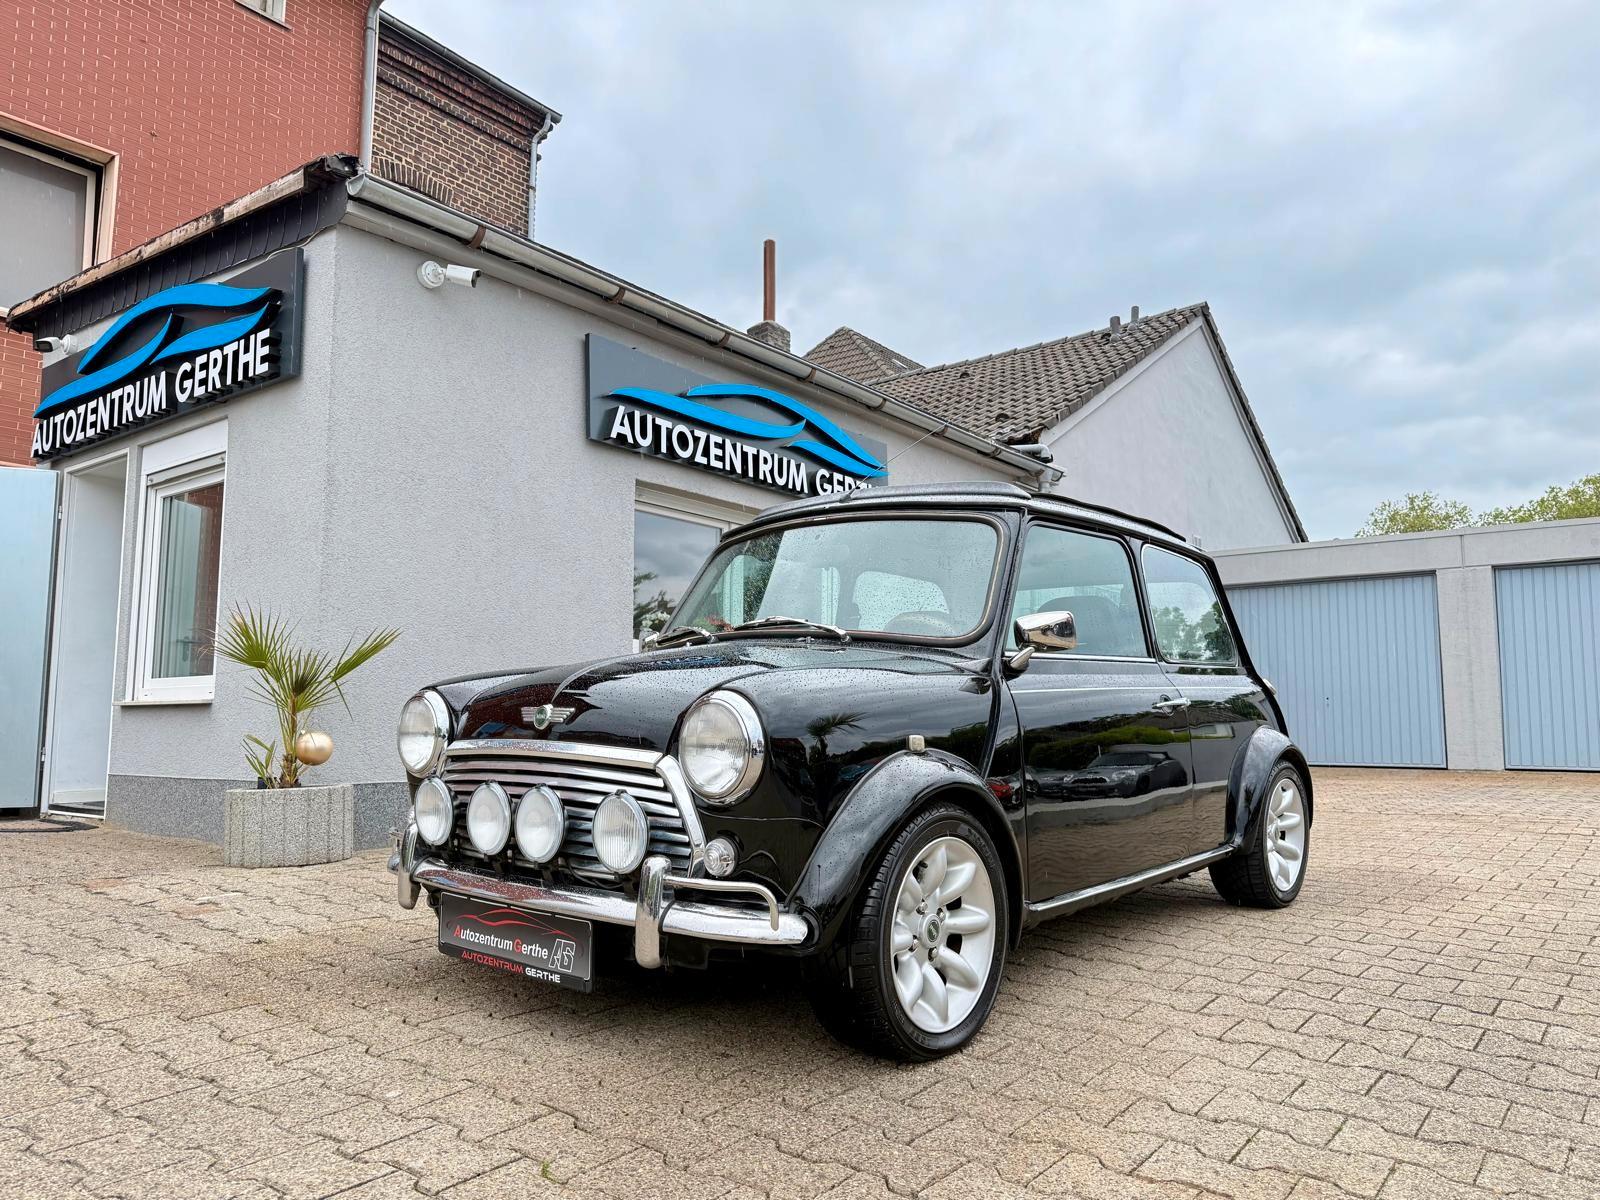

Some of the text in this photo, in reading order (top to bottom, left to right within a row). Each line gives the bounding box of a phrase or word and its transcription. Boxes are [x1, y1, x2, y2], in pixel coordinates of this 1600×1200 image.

[31, 328, 270, 458] AUTOZENTRUM GERTHE
[611, 405, 873, 496] AUTOZENTRUM GER
[453, 925, 548, 959] Autozentrum Gerthe
[462, 950, 561, 983] AUTOZENTRUM GERTHE
